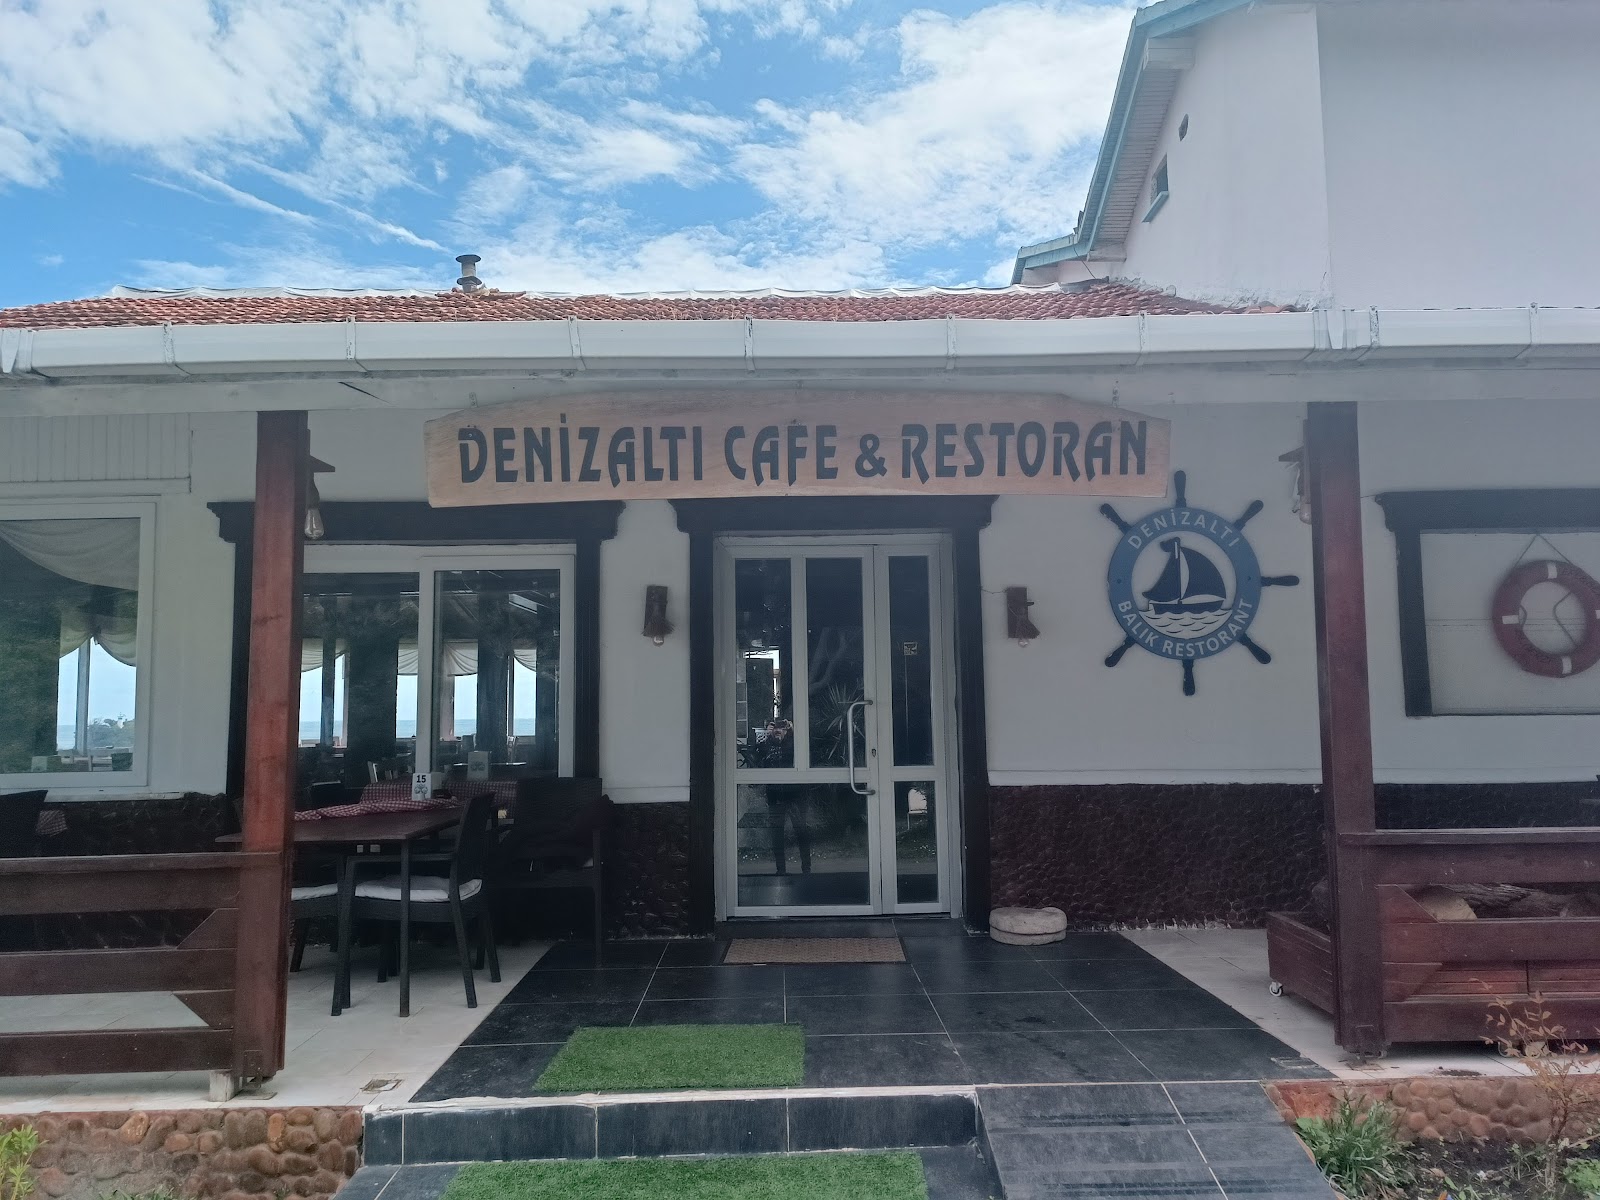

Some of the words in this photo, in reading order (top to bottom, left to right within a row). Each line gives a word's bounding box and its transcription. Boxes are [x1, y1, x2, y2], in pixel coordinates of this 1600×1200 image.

[458, 413, 703, 488] DENİZALTI
[724, 425, 838, 487] CAFE
[855, 433, 887, 478] &
[902, 420, 1147, 485] RESTORAN
[1127, 508, 1240, 550] DENİZALTI
[1118, 600, 1160, 648] BALIK
[1162, 598, 1253, 658] RESTORANT
[416, 774, 427, 783] 15
